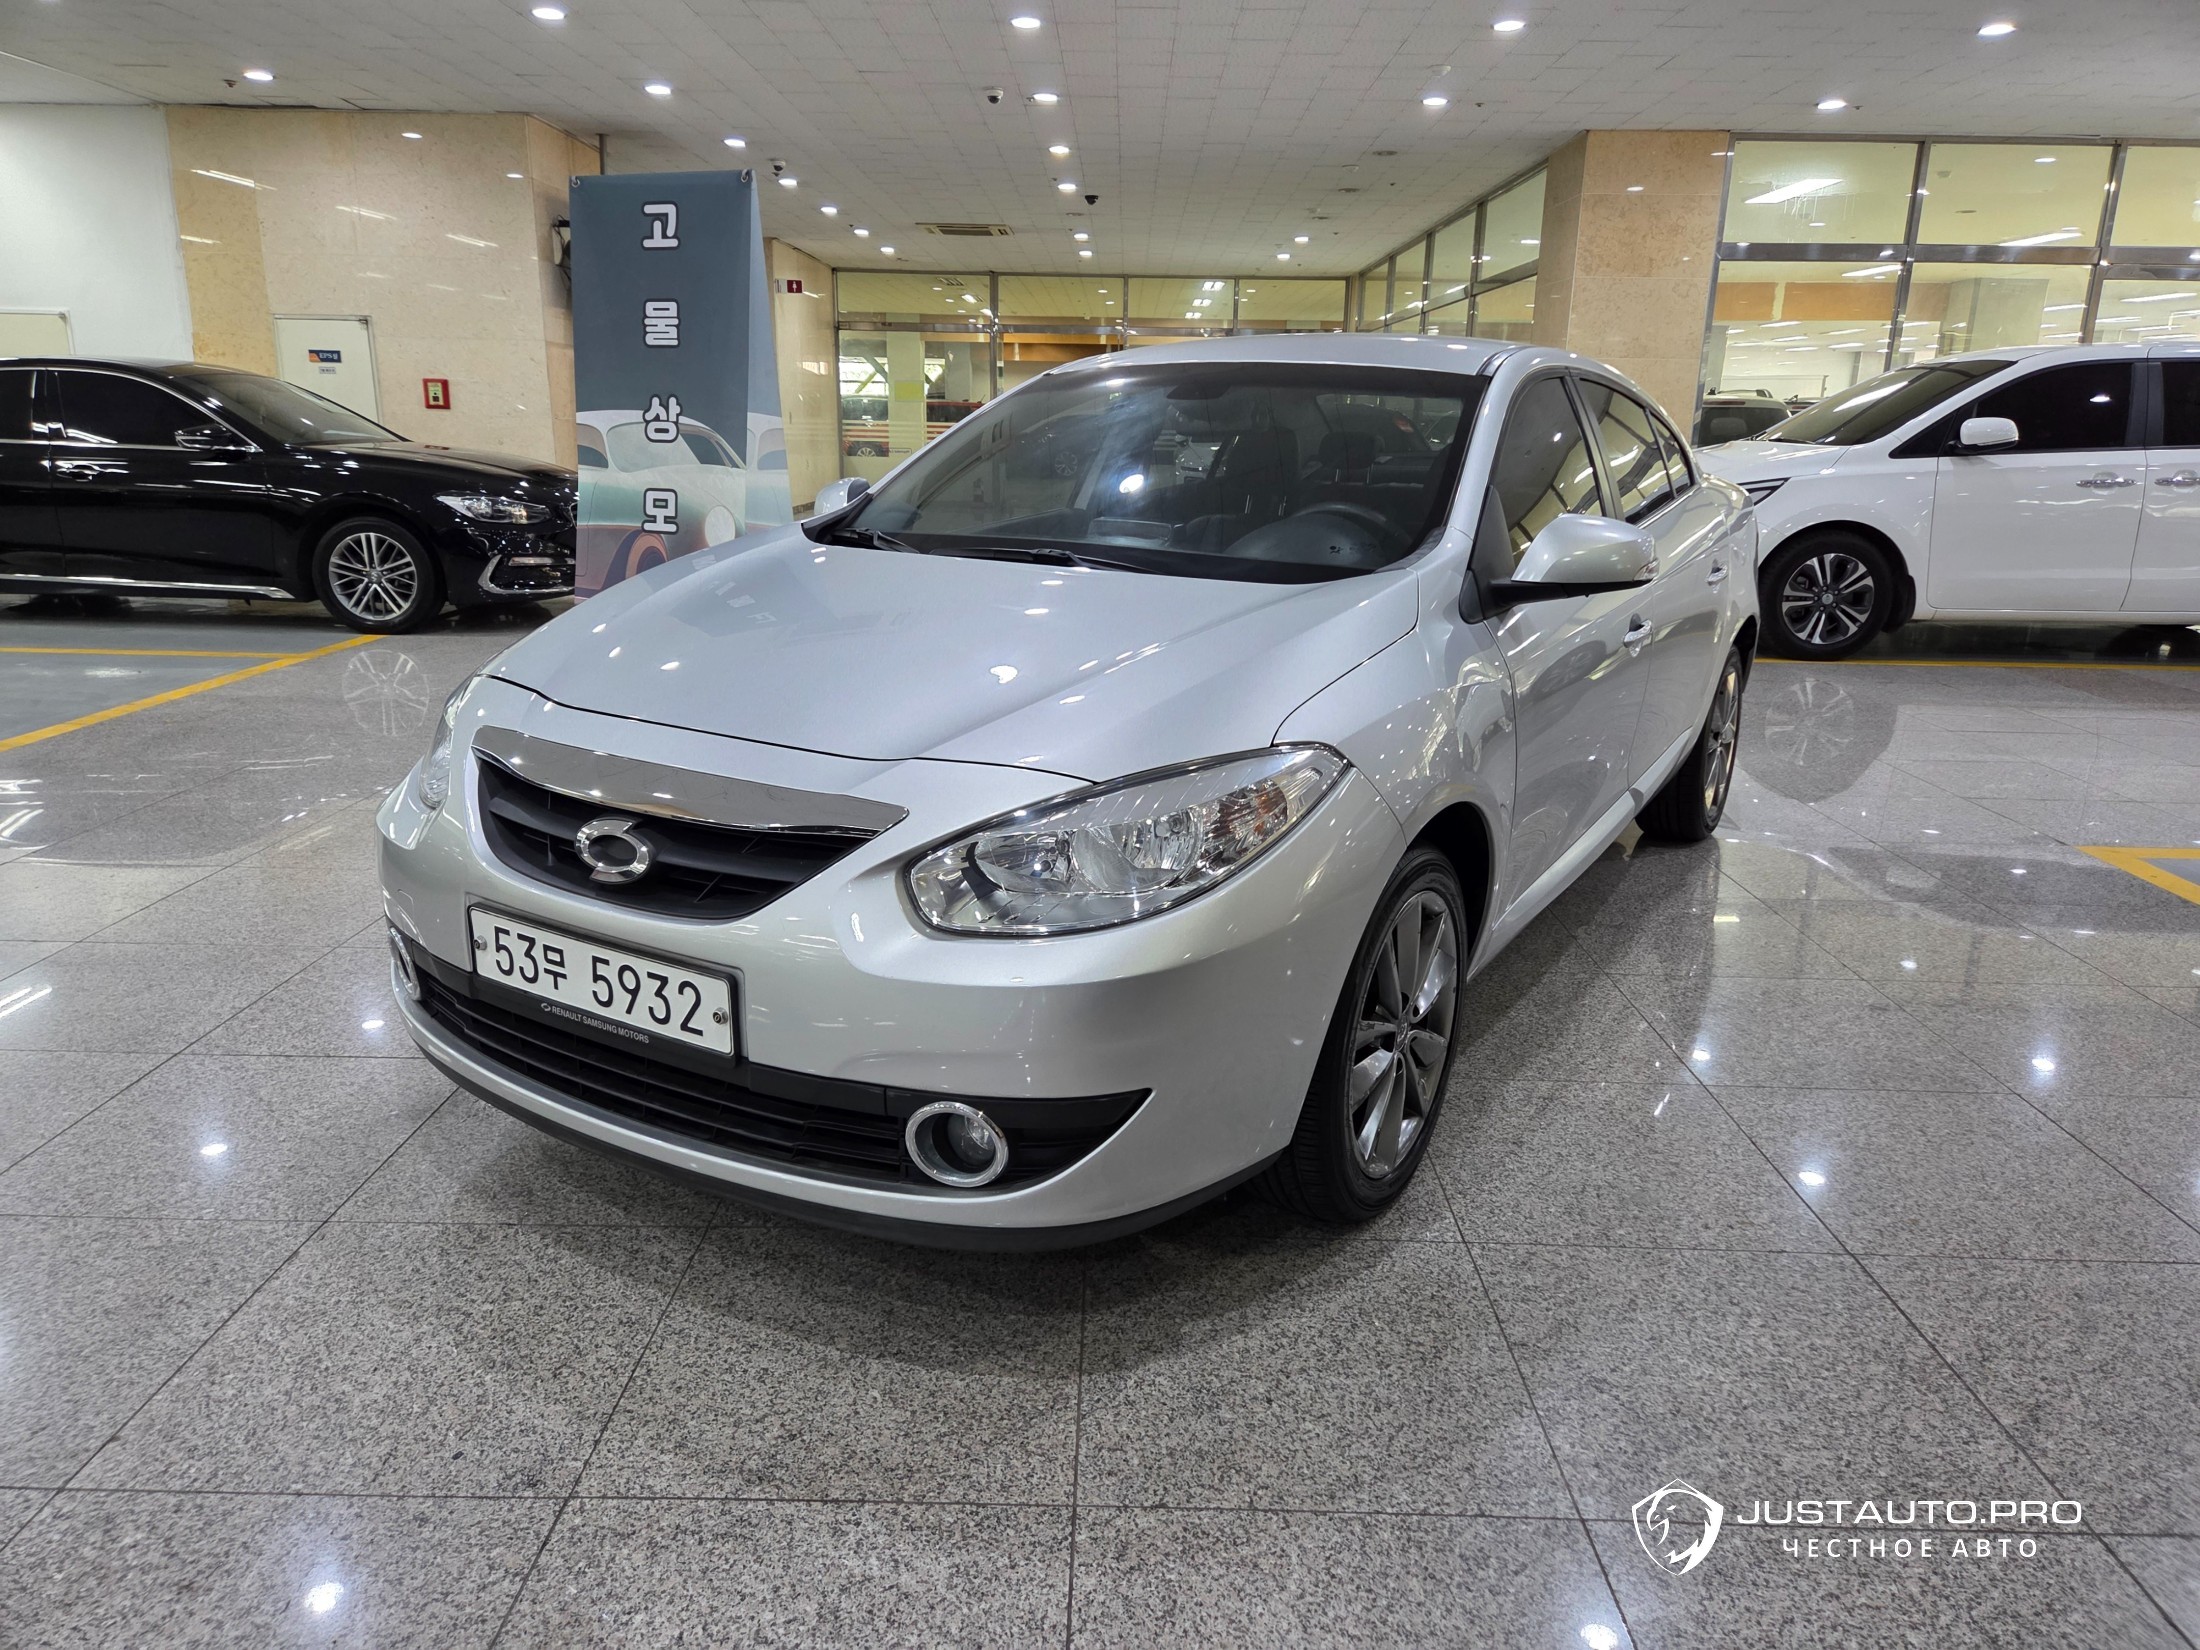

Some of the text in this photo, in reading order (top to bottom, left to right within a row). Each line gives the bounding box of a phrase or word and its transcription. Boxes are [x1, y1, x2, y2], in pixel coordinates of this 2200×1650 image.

[494, 926, 703, 1037] 53무 5932
[552, 1005, 650, 1044] RENAULT SAMSUNG MOTORS
